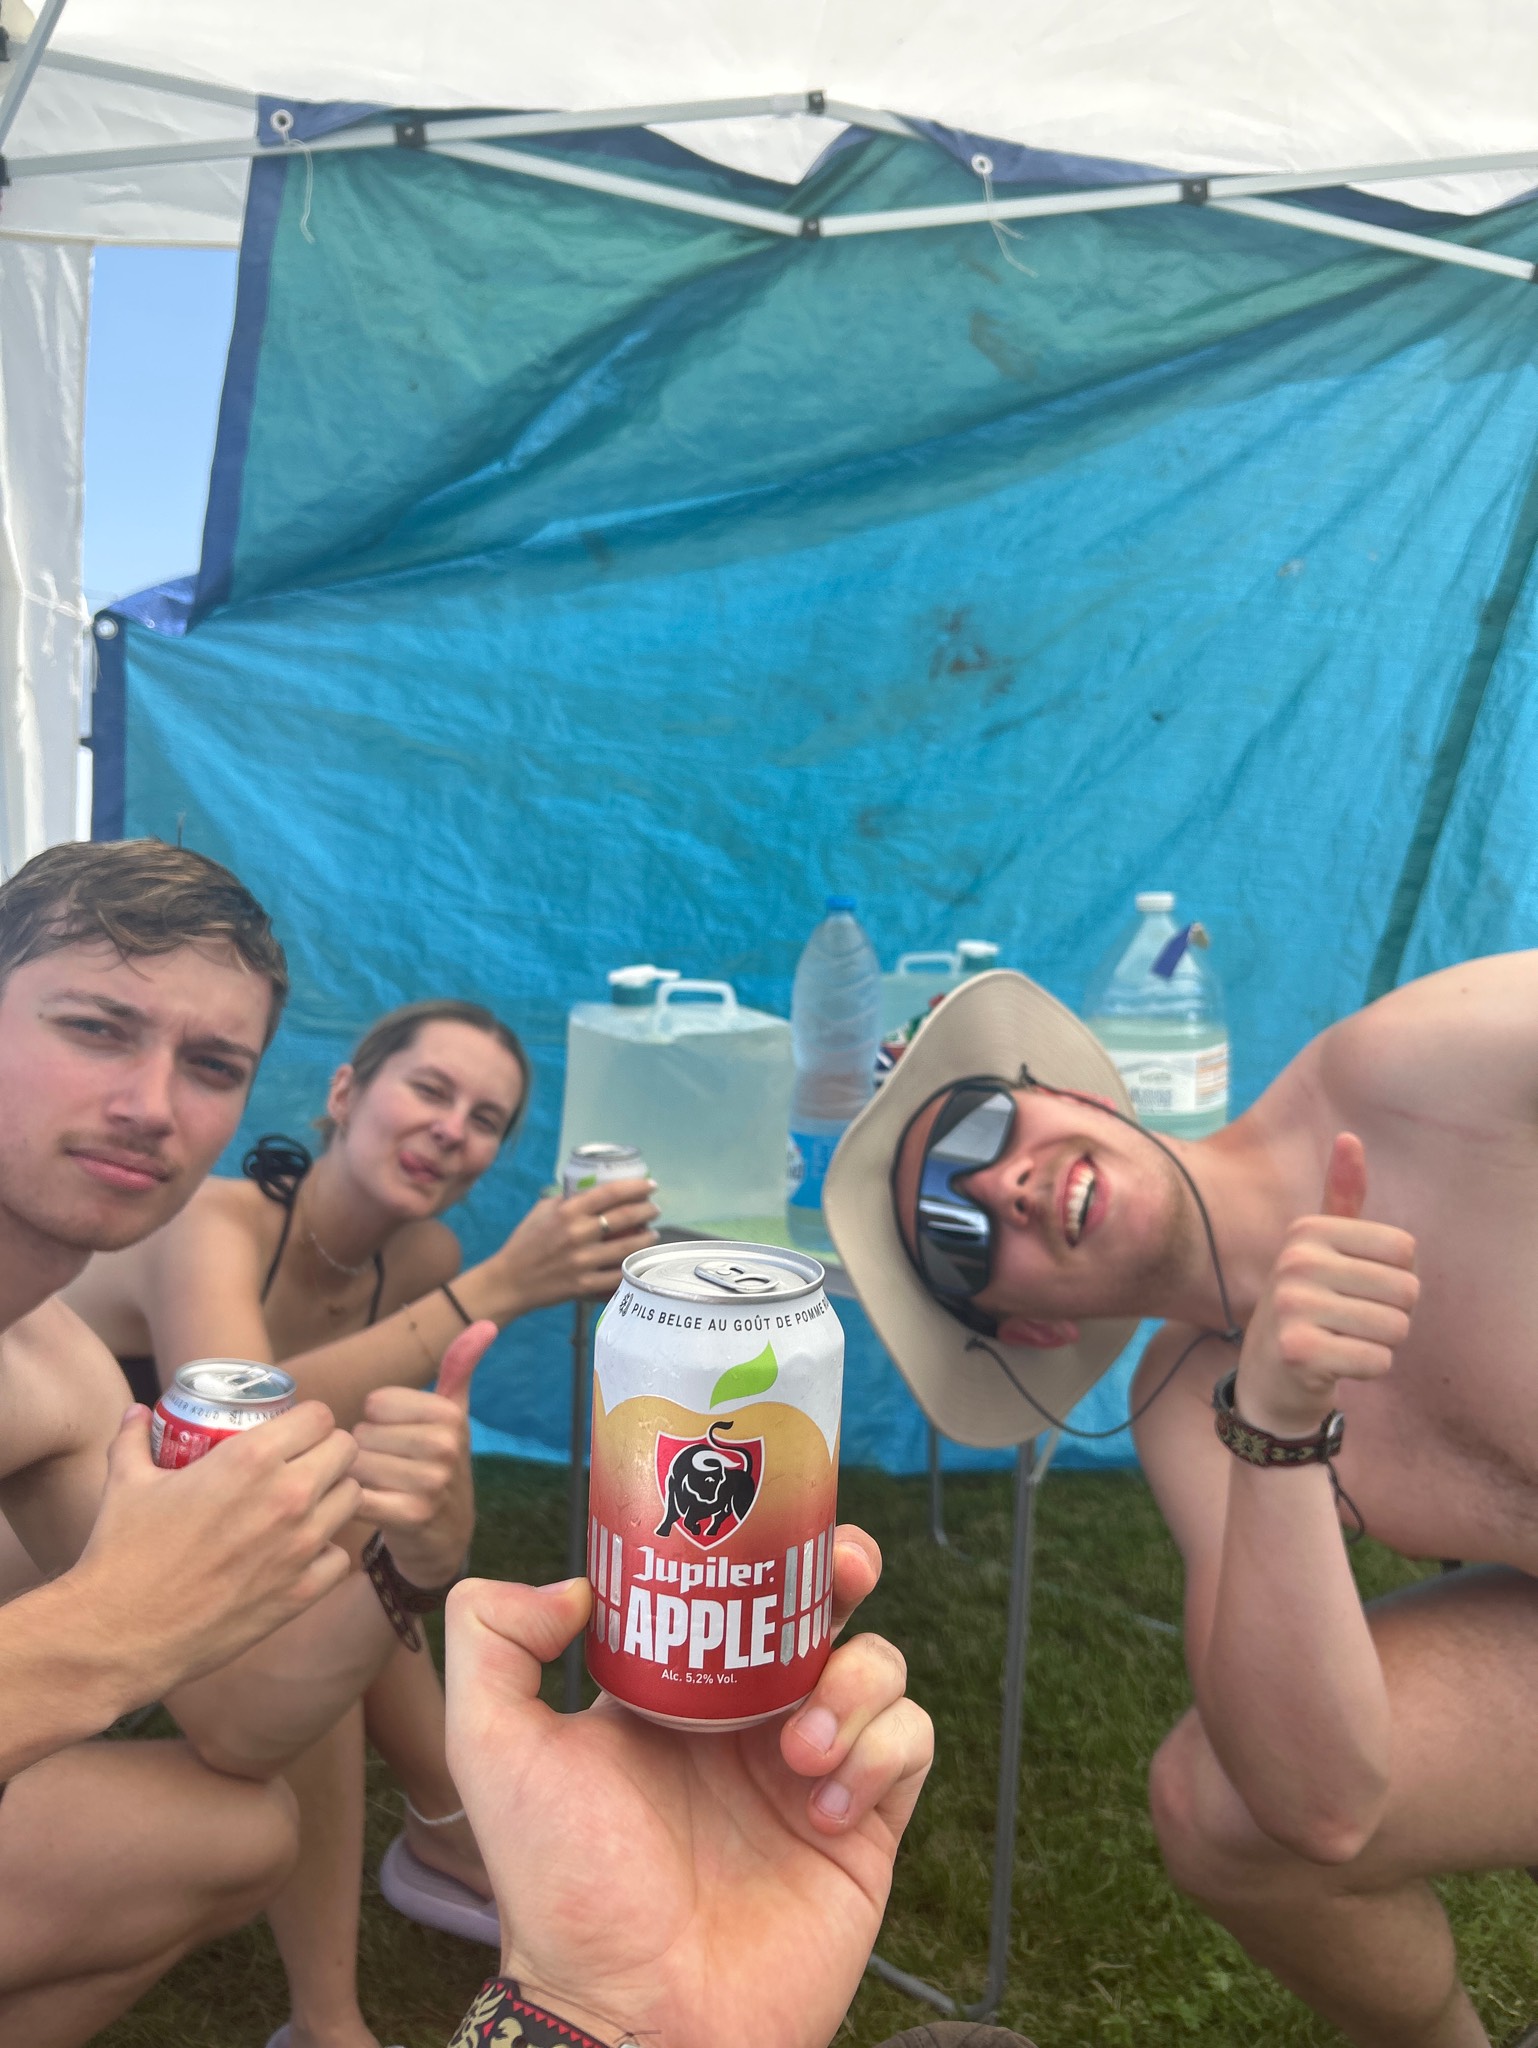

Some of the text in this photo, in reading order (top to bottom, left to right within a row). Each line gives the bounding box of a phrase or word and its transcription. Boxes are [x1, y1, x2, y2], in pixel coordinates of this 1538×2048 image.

[630, 1303, 825, 1332] PILS BELGE AU GOÛT DE POMME
[623, 1584, 777, 1670] APPLE
[661, 1668, 738, 1685] Alc. 5,2% Vol.
